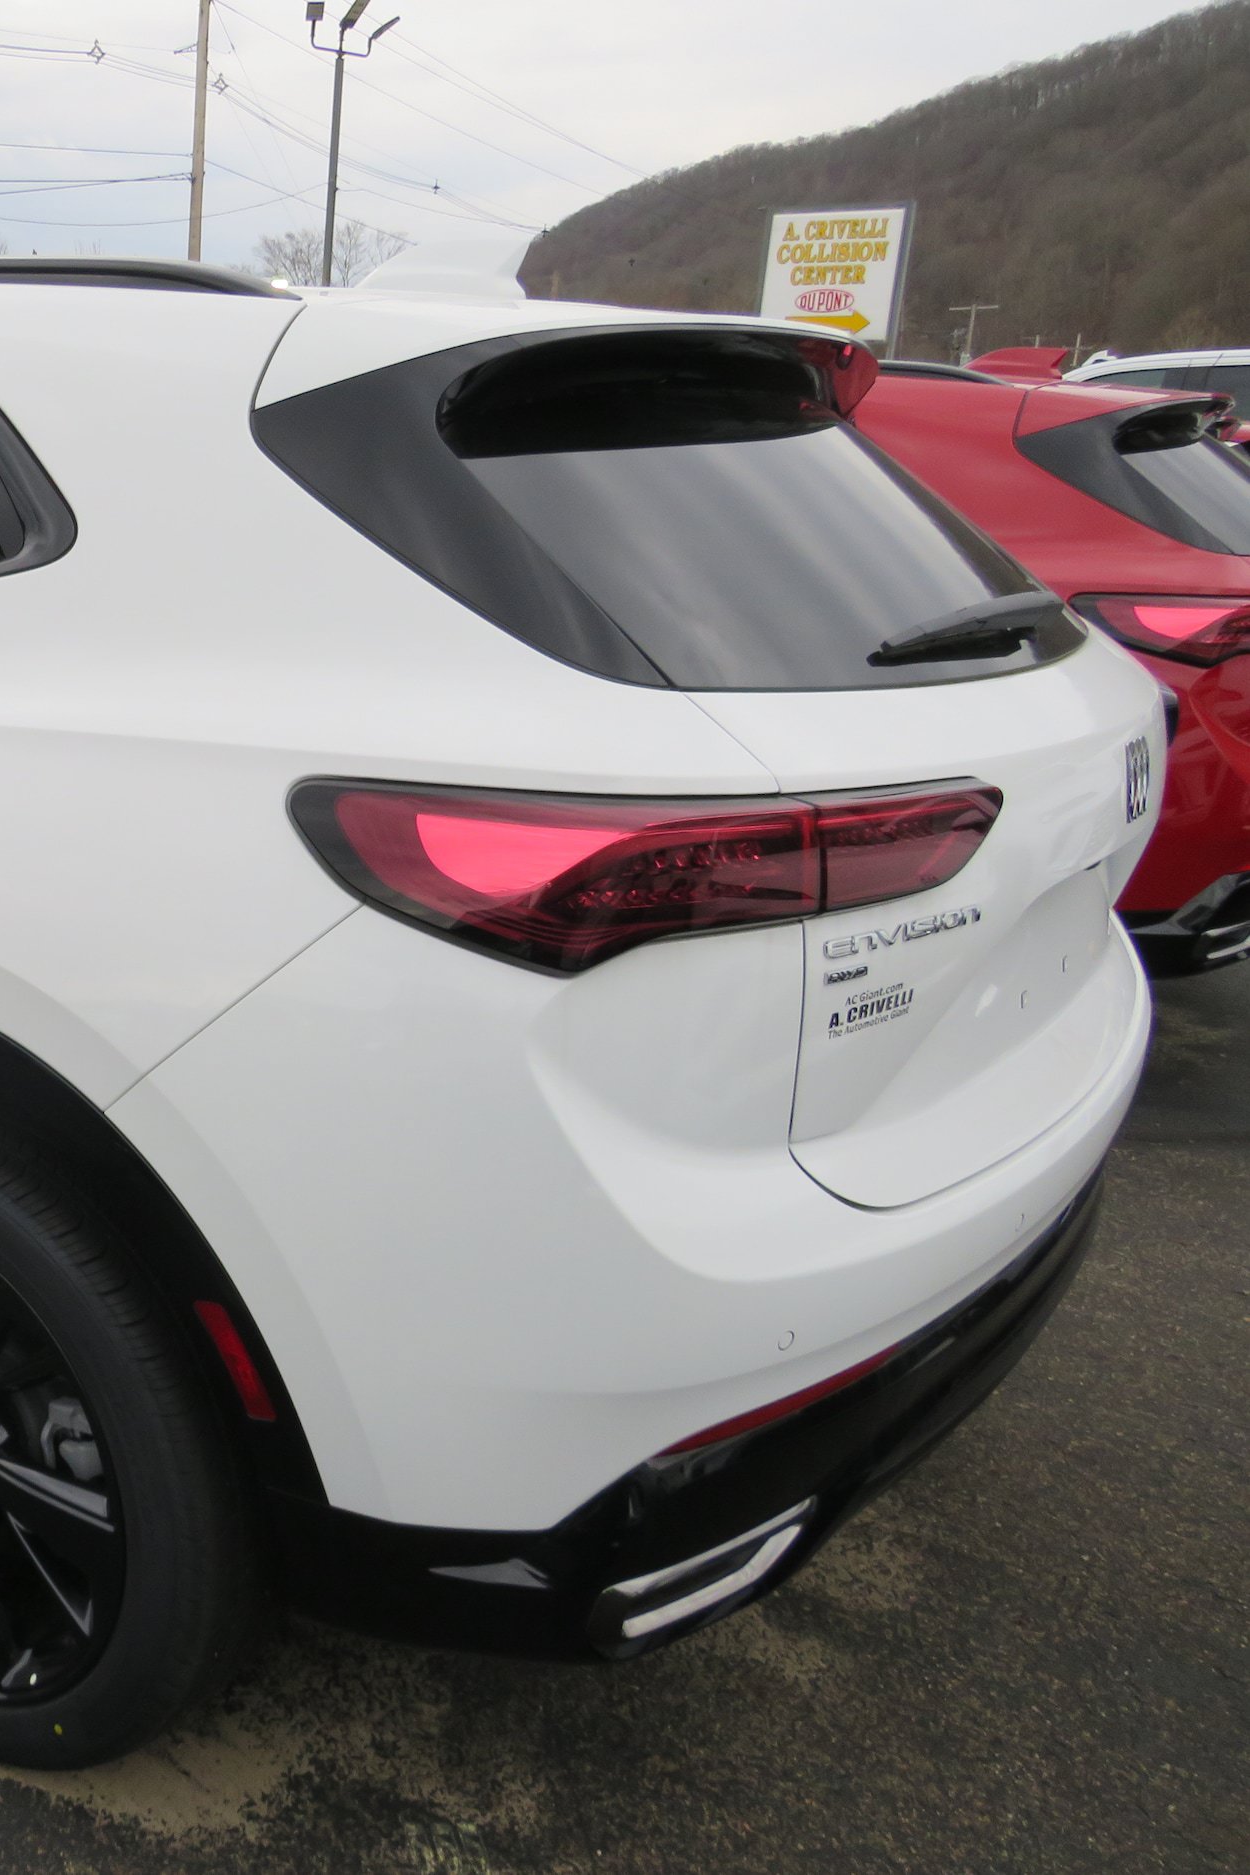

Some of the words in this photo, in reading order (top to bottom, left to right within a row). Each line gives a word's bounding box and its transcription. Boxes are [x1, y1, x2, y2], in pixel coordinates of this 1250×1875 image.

[782, 221, 800, 241] A.
[804, 218, 890, 241] CRIVELLI
[776, 241, 890, 264] COLLISION
[790, 264, 867, 286] CENTER
[828, 1012, 844, 1029] A.
[847, 988, 914, 1023] CRIVELLI
[828, 1029, 843, 1040] The
[890, 1006, 910, 1020] Giant
